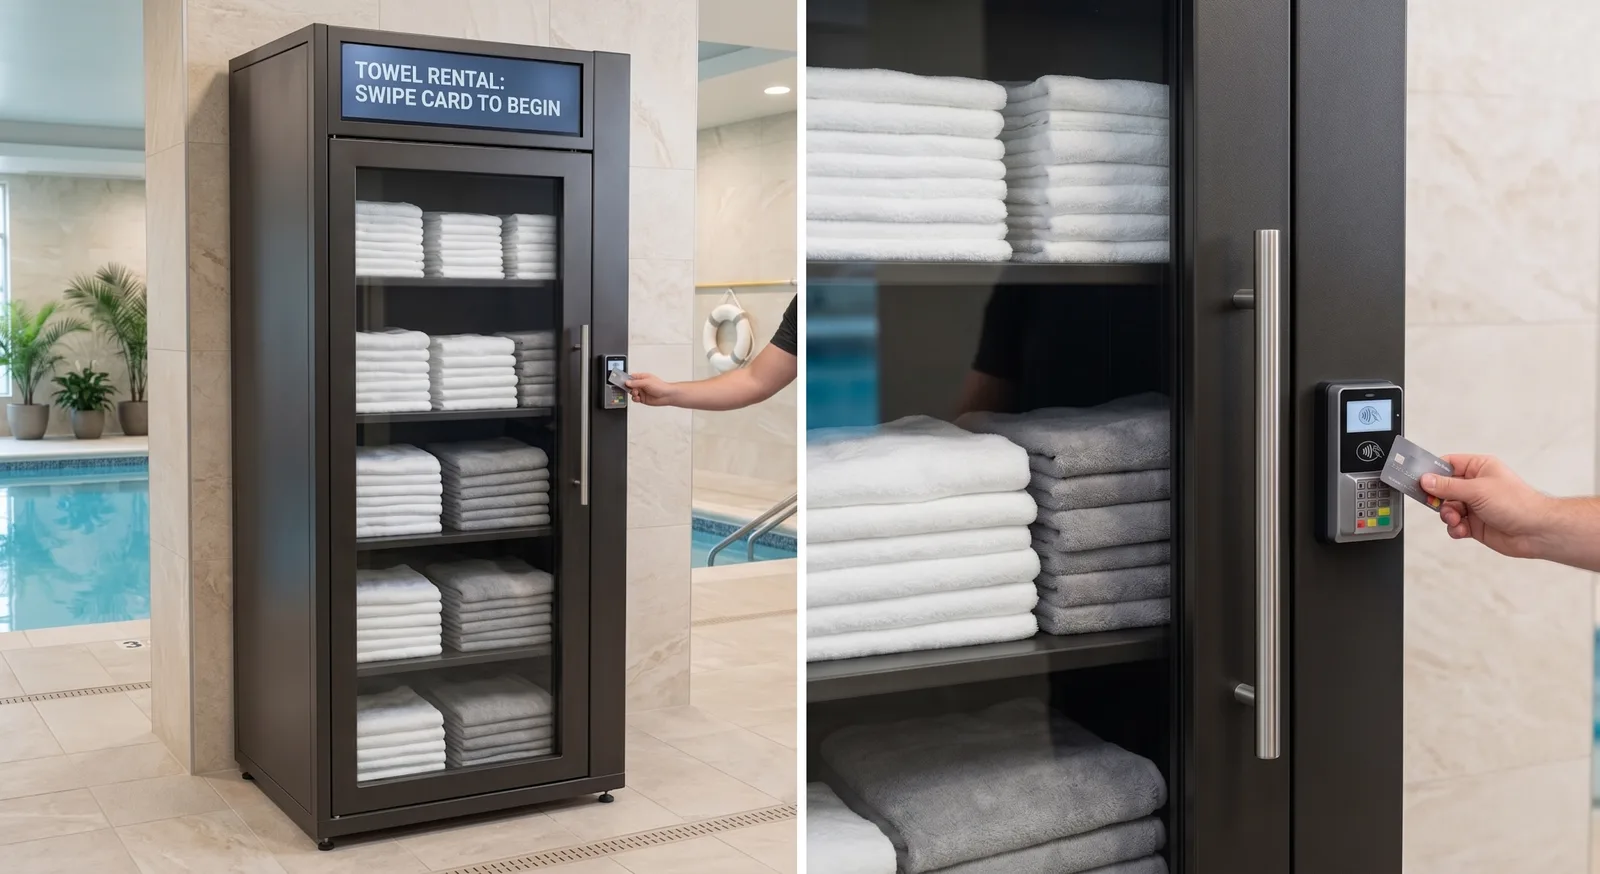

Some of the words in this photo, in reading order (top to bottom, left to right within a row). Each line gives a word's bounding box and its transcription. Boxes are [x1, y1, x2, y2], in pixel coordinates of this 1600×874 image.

[355, 61, 423, 84] TOWEL
[428, 67, 505, 90] RENTAL:
[355, 85, 417, 106] SWIPE
[421, 89, 473, 110] CARD
[477, 94, 502, 113] TO
[507, 97, 560, 117] BEGIN
